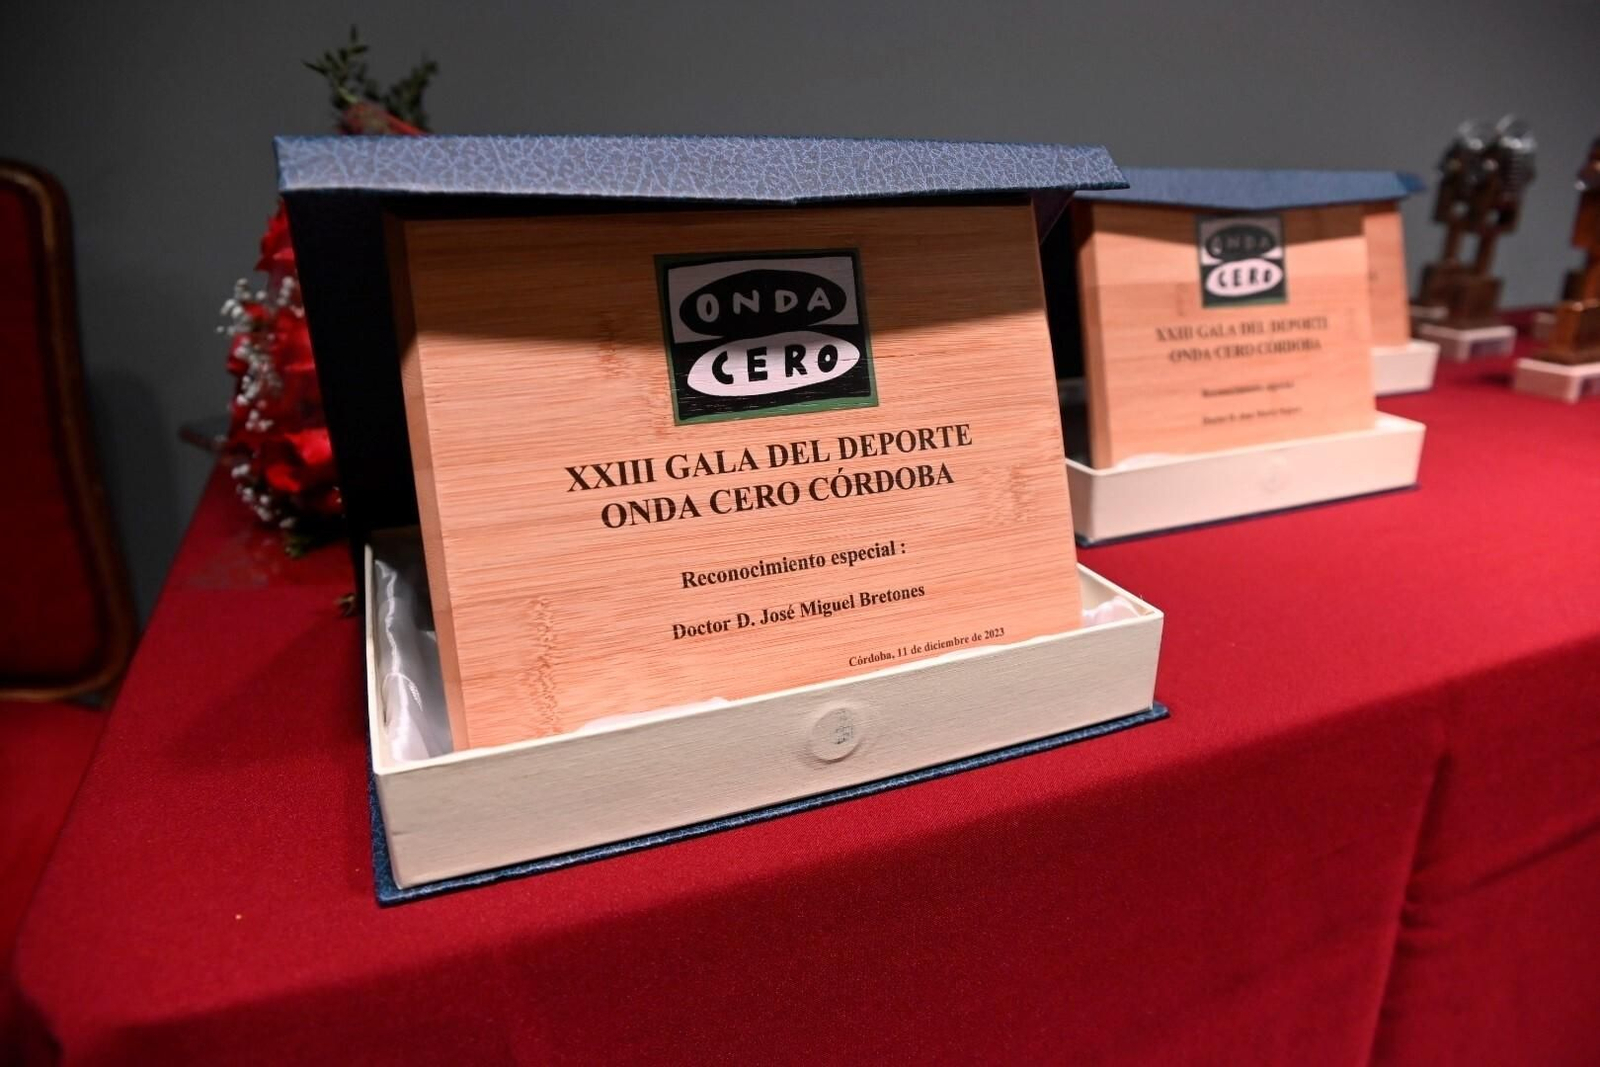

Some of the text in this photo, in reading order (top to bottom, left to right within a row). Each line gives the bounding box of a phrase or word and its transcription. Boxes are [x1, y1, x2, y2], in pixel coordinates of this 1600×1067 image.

[1217, 266, 1273, 288] CERO
[695, 286, 833, 323] ONDA
[1196, 323, 1237, 339] GALA
[711, 344, 839, 385] CERO
[564, 423, 973, 492] XXIII GALA DEL DEPORTE
[601, 462, 955, 529] ONDA CERO CÓRDOBA
[681, 553, 826, 588] Reconocimiento
[831, 540, 896, 569] especial
[672, 584, 925, 640] Doctor D. José Miguel Bretones
[849, 627, 1005, 667] Córdoba, 11 de diciembre de 2023
